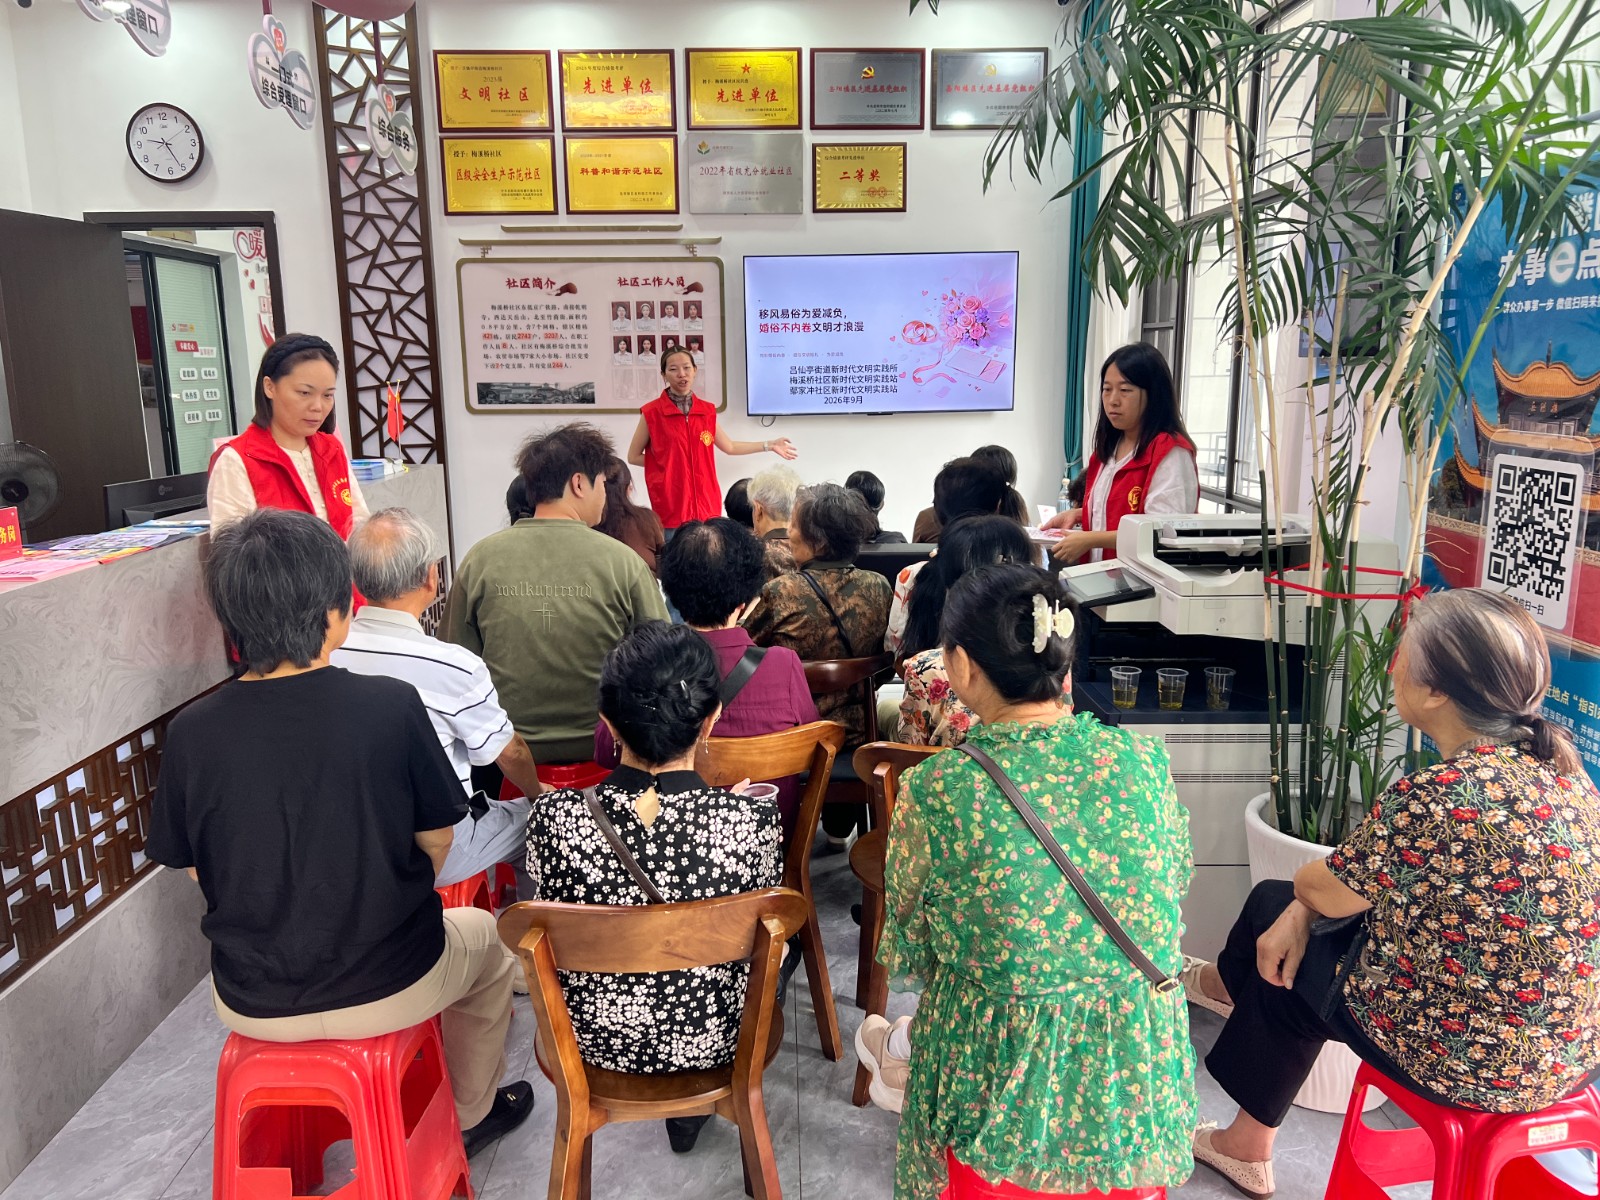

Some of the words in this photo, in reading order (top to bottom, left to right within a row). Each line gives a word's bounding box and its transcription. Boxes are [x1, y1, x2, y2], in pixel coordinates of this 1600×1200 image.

[583, 75, 653, 95] 先进单位
[459, 85, 529, 101] 文明社区
[716, 87, 779, 104] 先进单位
[146, 117, 153, 125] 11
[158, 112, 167, 121] 12
[139, 126, 147, 134] 10
[184, 124, 190, 133] 2
[136, 140, 142, 149] 9
[190, 138, 196, 147] 3
[143, 154, 149, 163] 8
[154, 163, 159, 171] 7
[167, 166, 173, 175] 6
[180, 163, 186, 171] 5
[580, 167, 663, 176] 科普和谐示范社区
[699, 165, 793, 177] 2022年省级充分就业社区
[456, 166, 541, 182] 区级安全生产示范社区
[839, 167, 881, 183] 二等奖
[506, 277, 557, 290] 社区简介
[617, 276, 685, 288] 社区工作人员
[1503, 298, 1554, 313] 群众办事第一步
[790, 364, 898, 375] 吕仙亭街道新时代文明实践所
[790, 374, 898, 385] 梅溪桥社区新时代文明实践站
[824, 396, 863, 405] 2026年9月
[495, 581, 592, 599] walkuptrend
